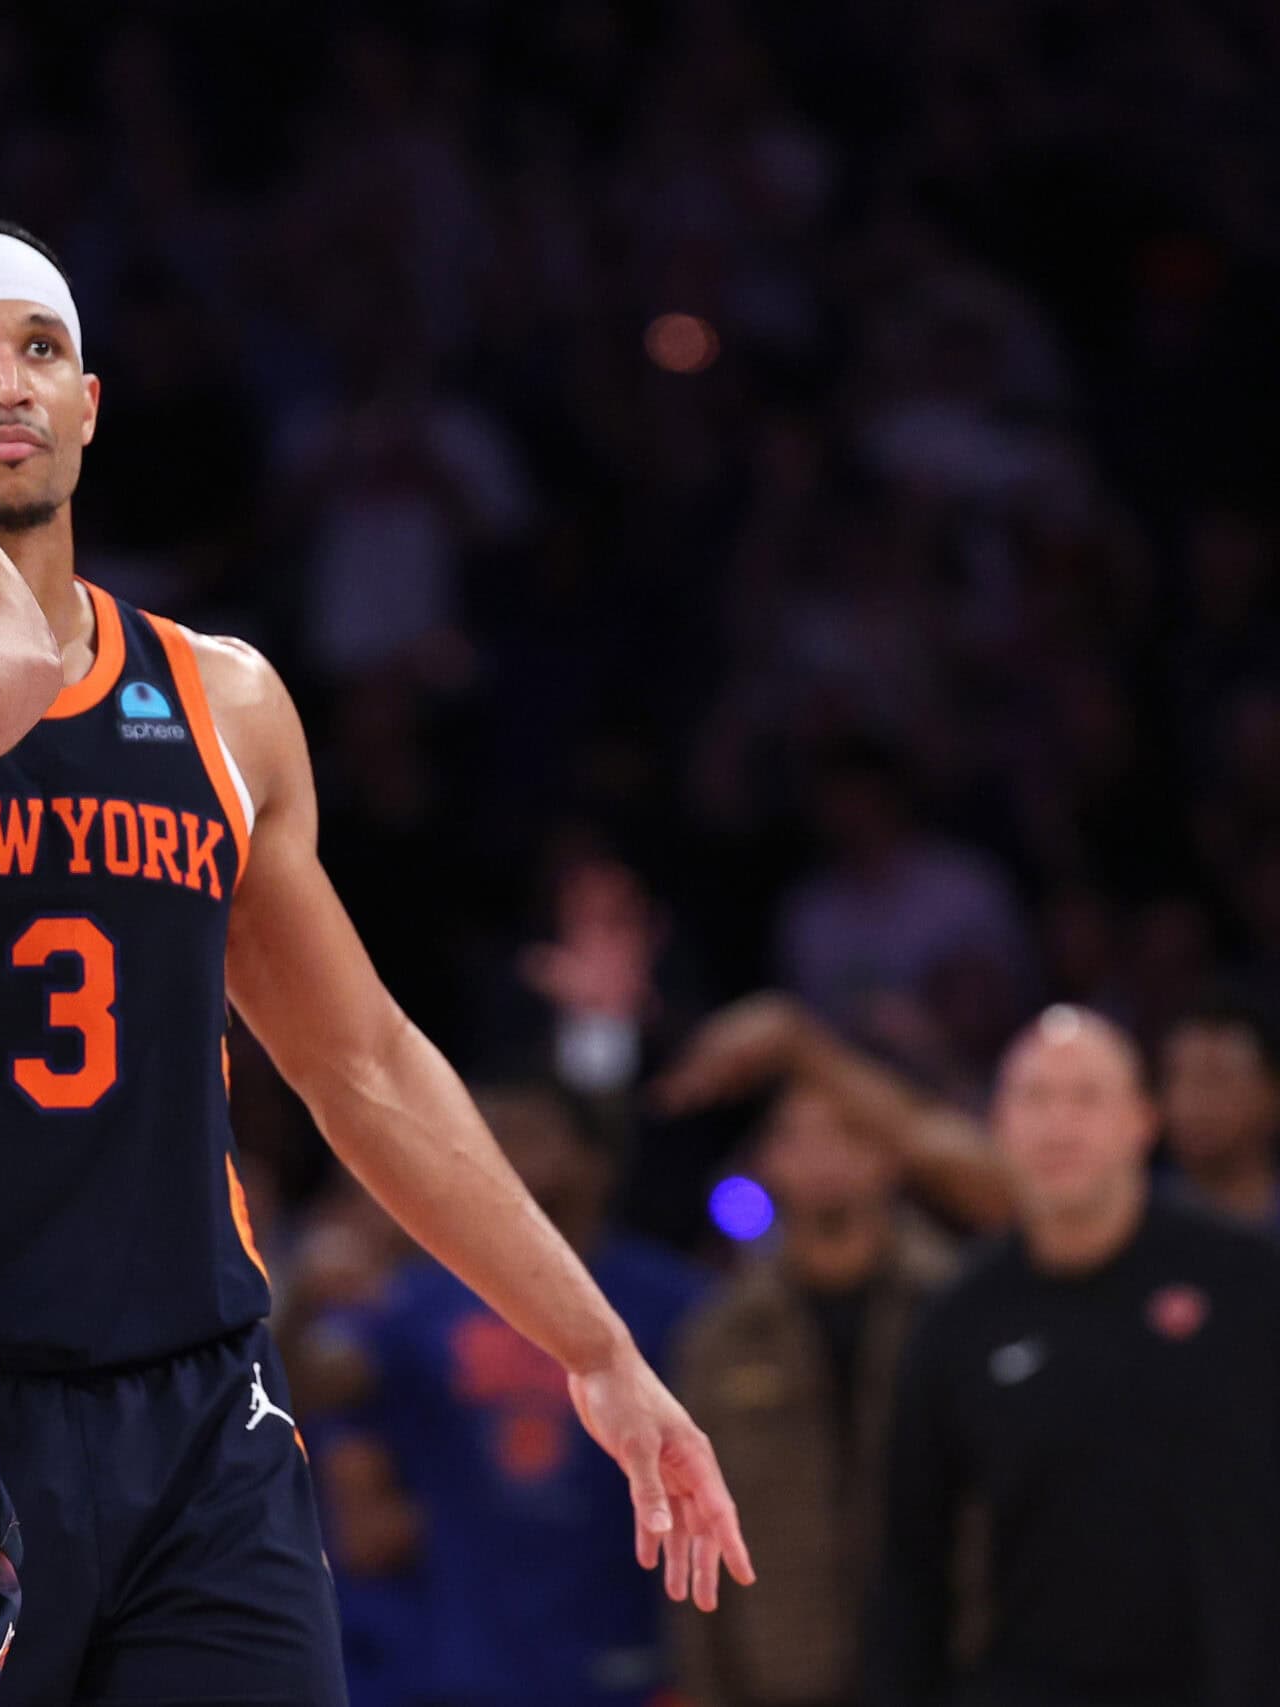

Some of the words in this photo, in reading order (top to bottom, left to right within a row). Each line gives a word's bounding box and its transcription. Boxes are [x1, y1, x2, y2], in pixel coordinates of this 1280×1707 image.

[121, 723, 185, 741] sphere
[51, 798, 224, 900] YORK
[11, 917, 117, 1109] 3
